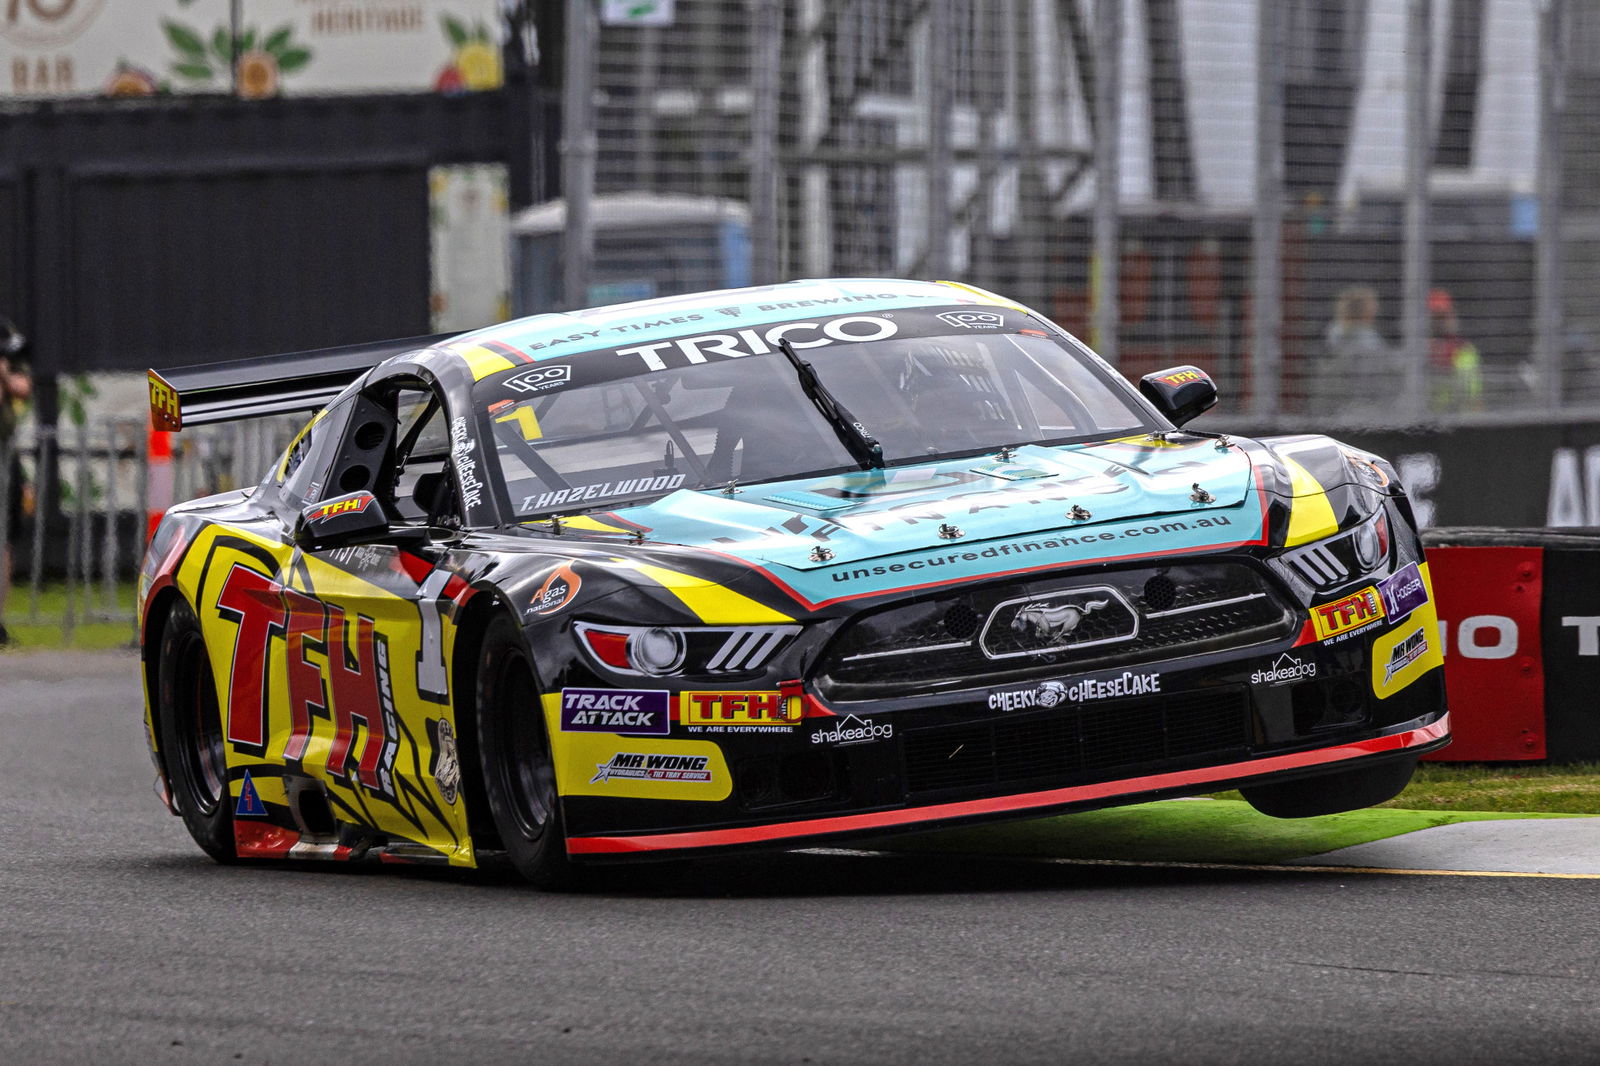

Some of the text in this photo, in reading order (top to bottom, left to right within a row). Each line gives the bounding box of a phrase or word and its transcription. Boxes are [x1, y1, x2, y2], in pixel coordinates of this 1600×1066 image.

[529, 292, 898, 351] EASY TIMES BREWING
[946, 314, 998, 328] 100
[616, 316, 898, 372] TRICO
[513, 367, 566, 391] 100
[538, 381, 565, 391] YEARS
[1165, 371, 1199, 384] TFH
[147, 375, 179, 418] TFH
[495, 405, 543, 440] 1
[520, 473, 687, 512] T.HAZELWOOD
[320, 499, 359, 515] TFH
[831, 514, 1231, 582] unsecuredfinance.com.au
[1318, 593, 1373, 630] TFH
[415, 569, 448, 695] 1
[1323, 620, 1383, 646] WE ARE EVERYWHERE
[1393, 641, 1406, 660] MR
[216, 563, 386, 791] TFH
[1251, 657, 1316, 684] shakeadog
[565, 694, 644, 711] TRACK
[988, 672, 1161, 711] CHEEKY CHEESECAKE
[377, 640, 398, 798] RACING
[571, 711, 655, 726] ATTACK
[692, 695, 779, 719] TFH
[811, 719, 893, 744] shakeadog
[613, 753, 708, 771] MR WONG
[681, 772, 708, 780] SERVICE
